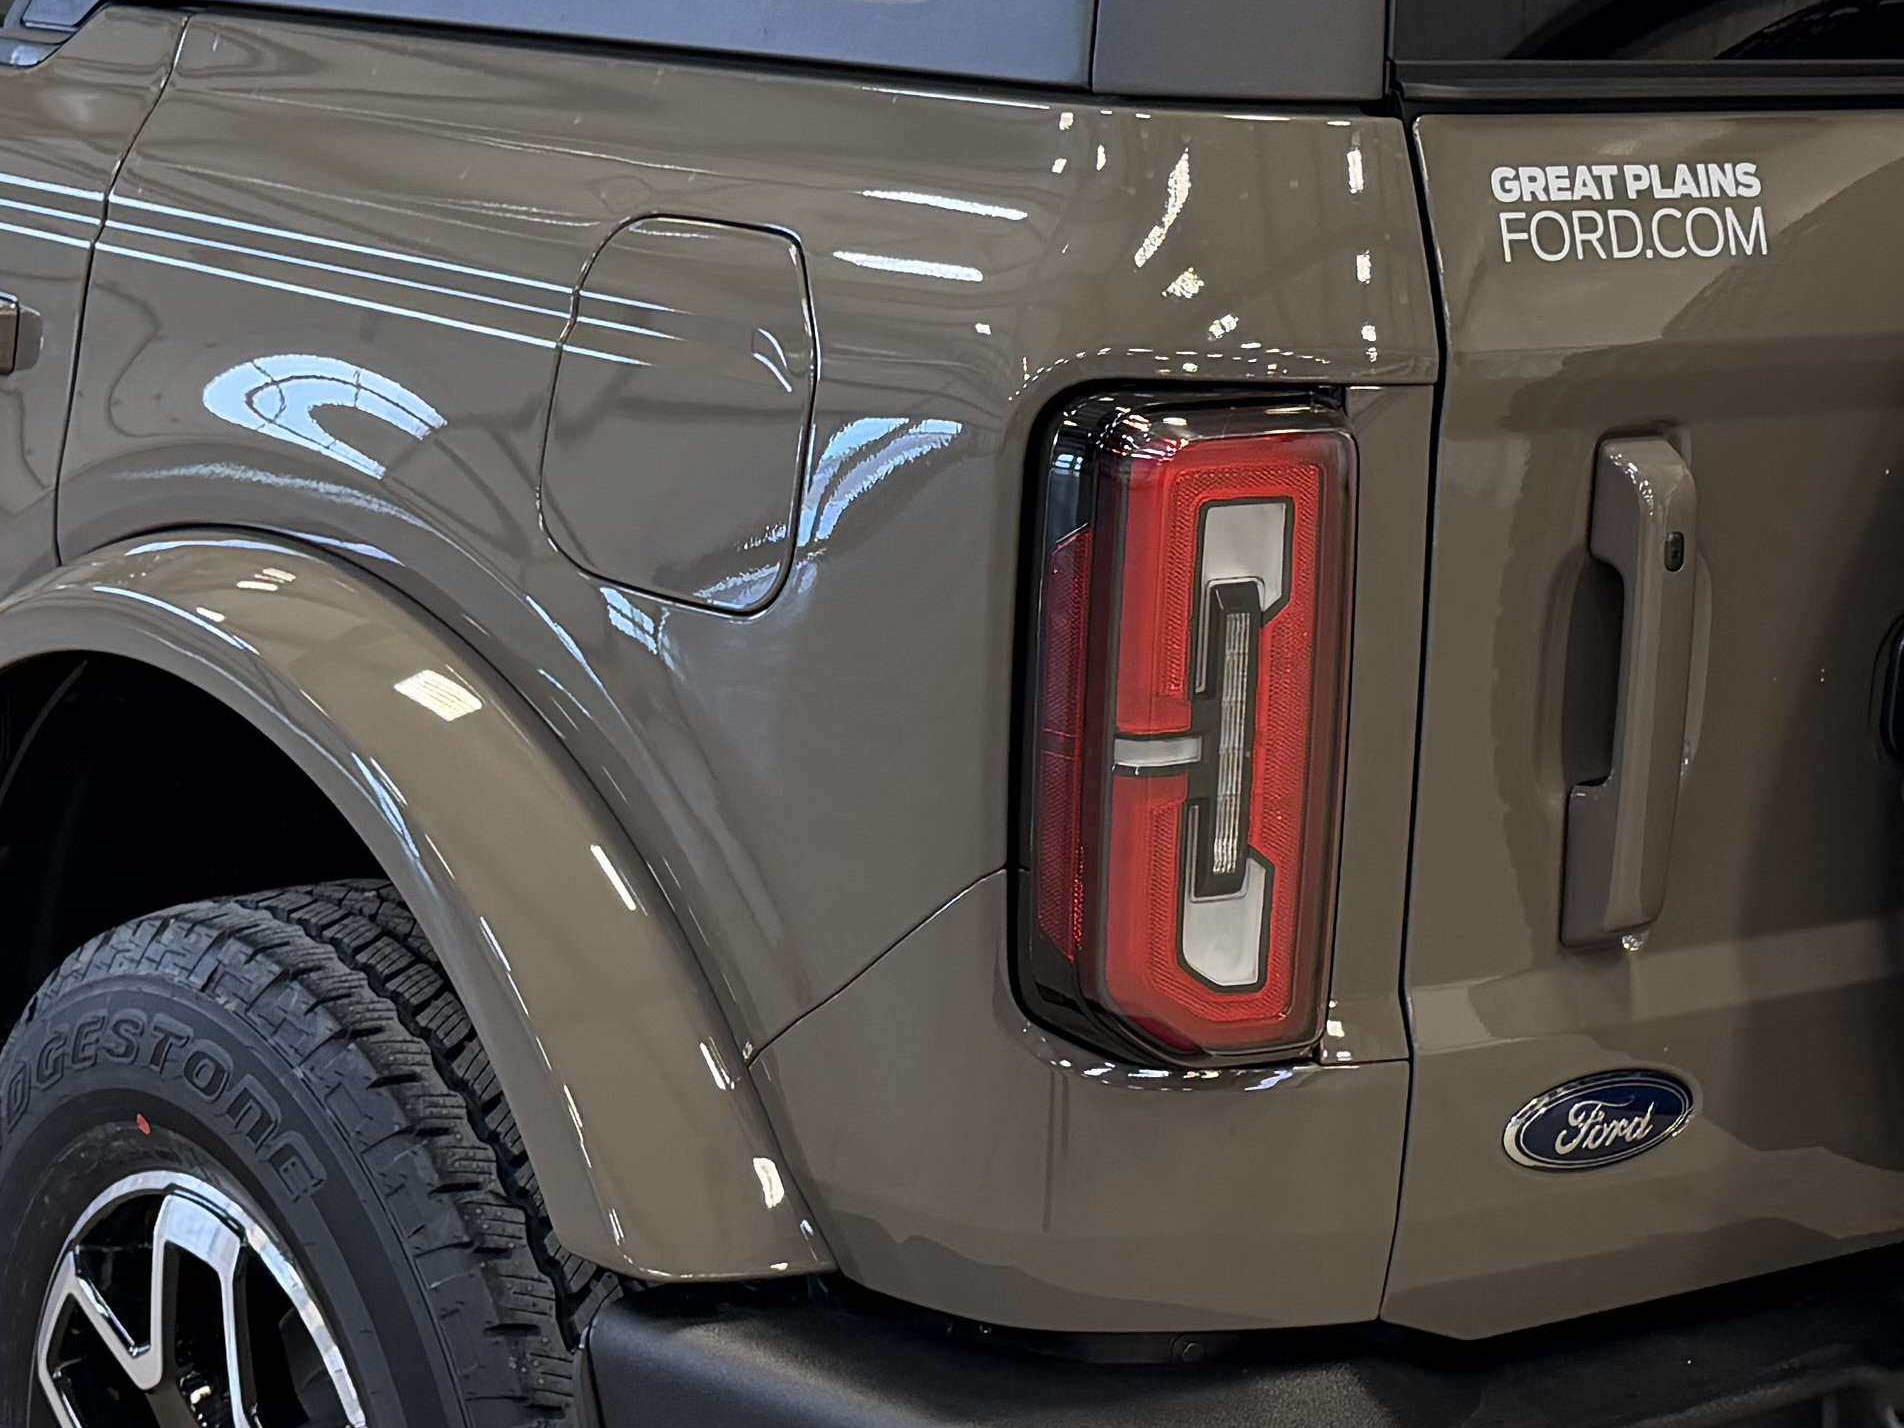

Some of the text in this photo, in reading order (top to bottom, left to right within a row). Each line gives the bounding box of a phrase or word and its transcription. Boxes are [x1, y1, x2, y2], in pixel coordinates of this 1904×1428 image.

[1490, 162, 1762, 203] GREAT PLAINS
[1498, 205, 1769, 263] FORD.COM
[1554, 1094, 1656, 1156] Ford
